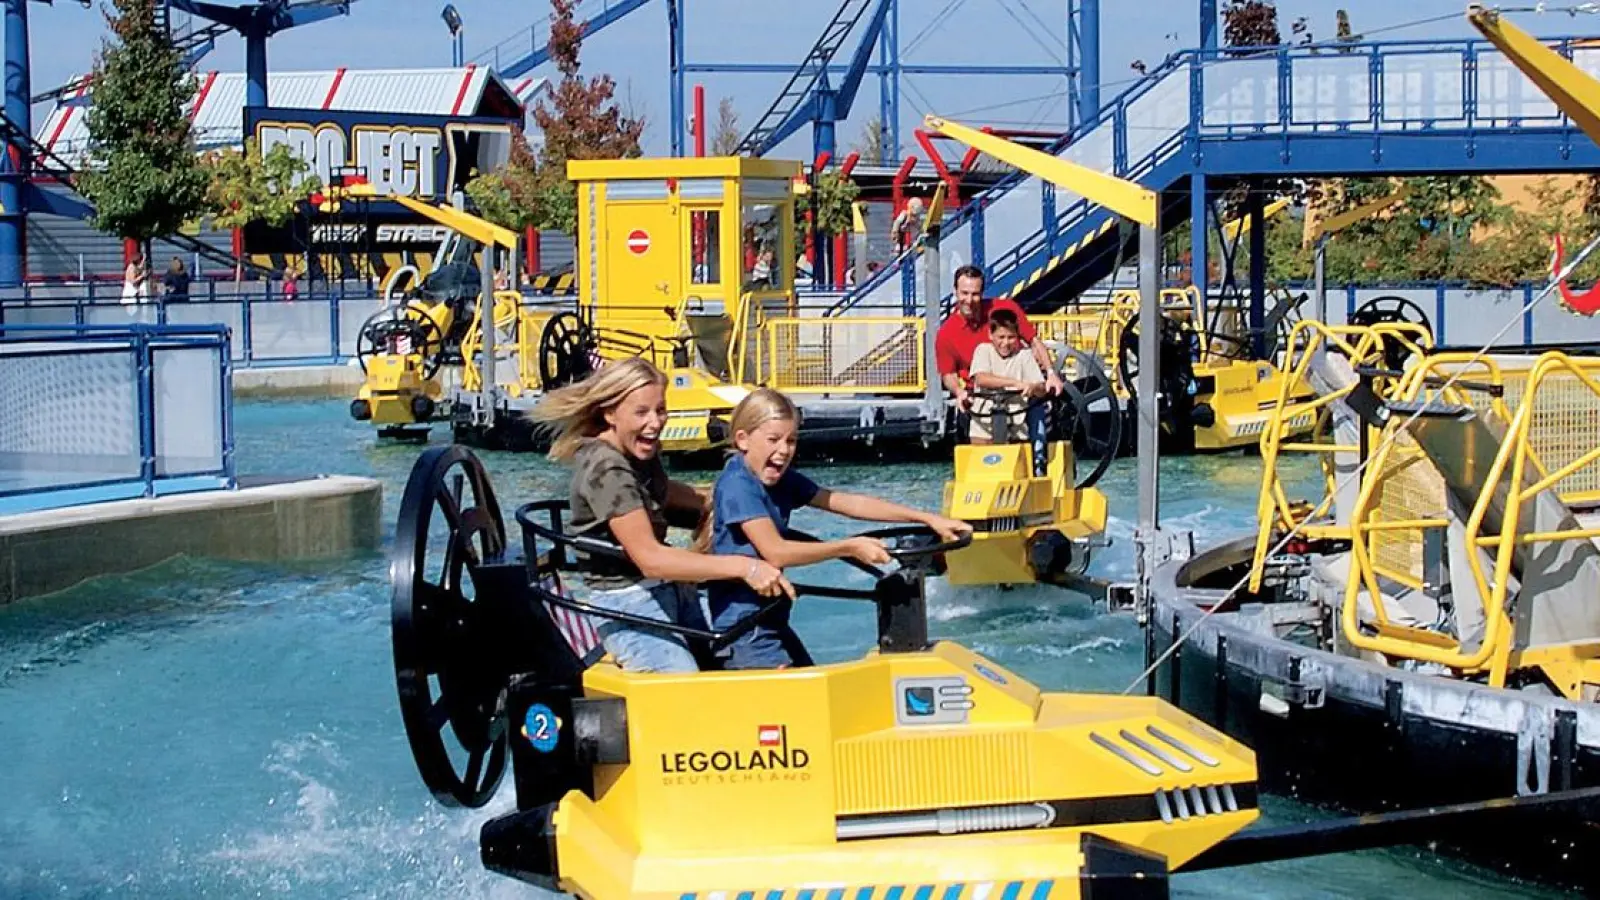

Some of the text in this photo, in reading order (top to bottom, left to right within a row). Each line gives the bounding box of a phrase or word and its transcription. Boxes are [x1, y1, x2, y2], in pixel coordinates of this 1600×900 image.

[375, 223, 448, 243] STREC
[534, 712, 550, 740] 2
[661, 724, 810, 772] LEGOLAND
[662, 772, 812, 786] DEUTSCHLAND
